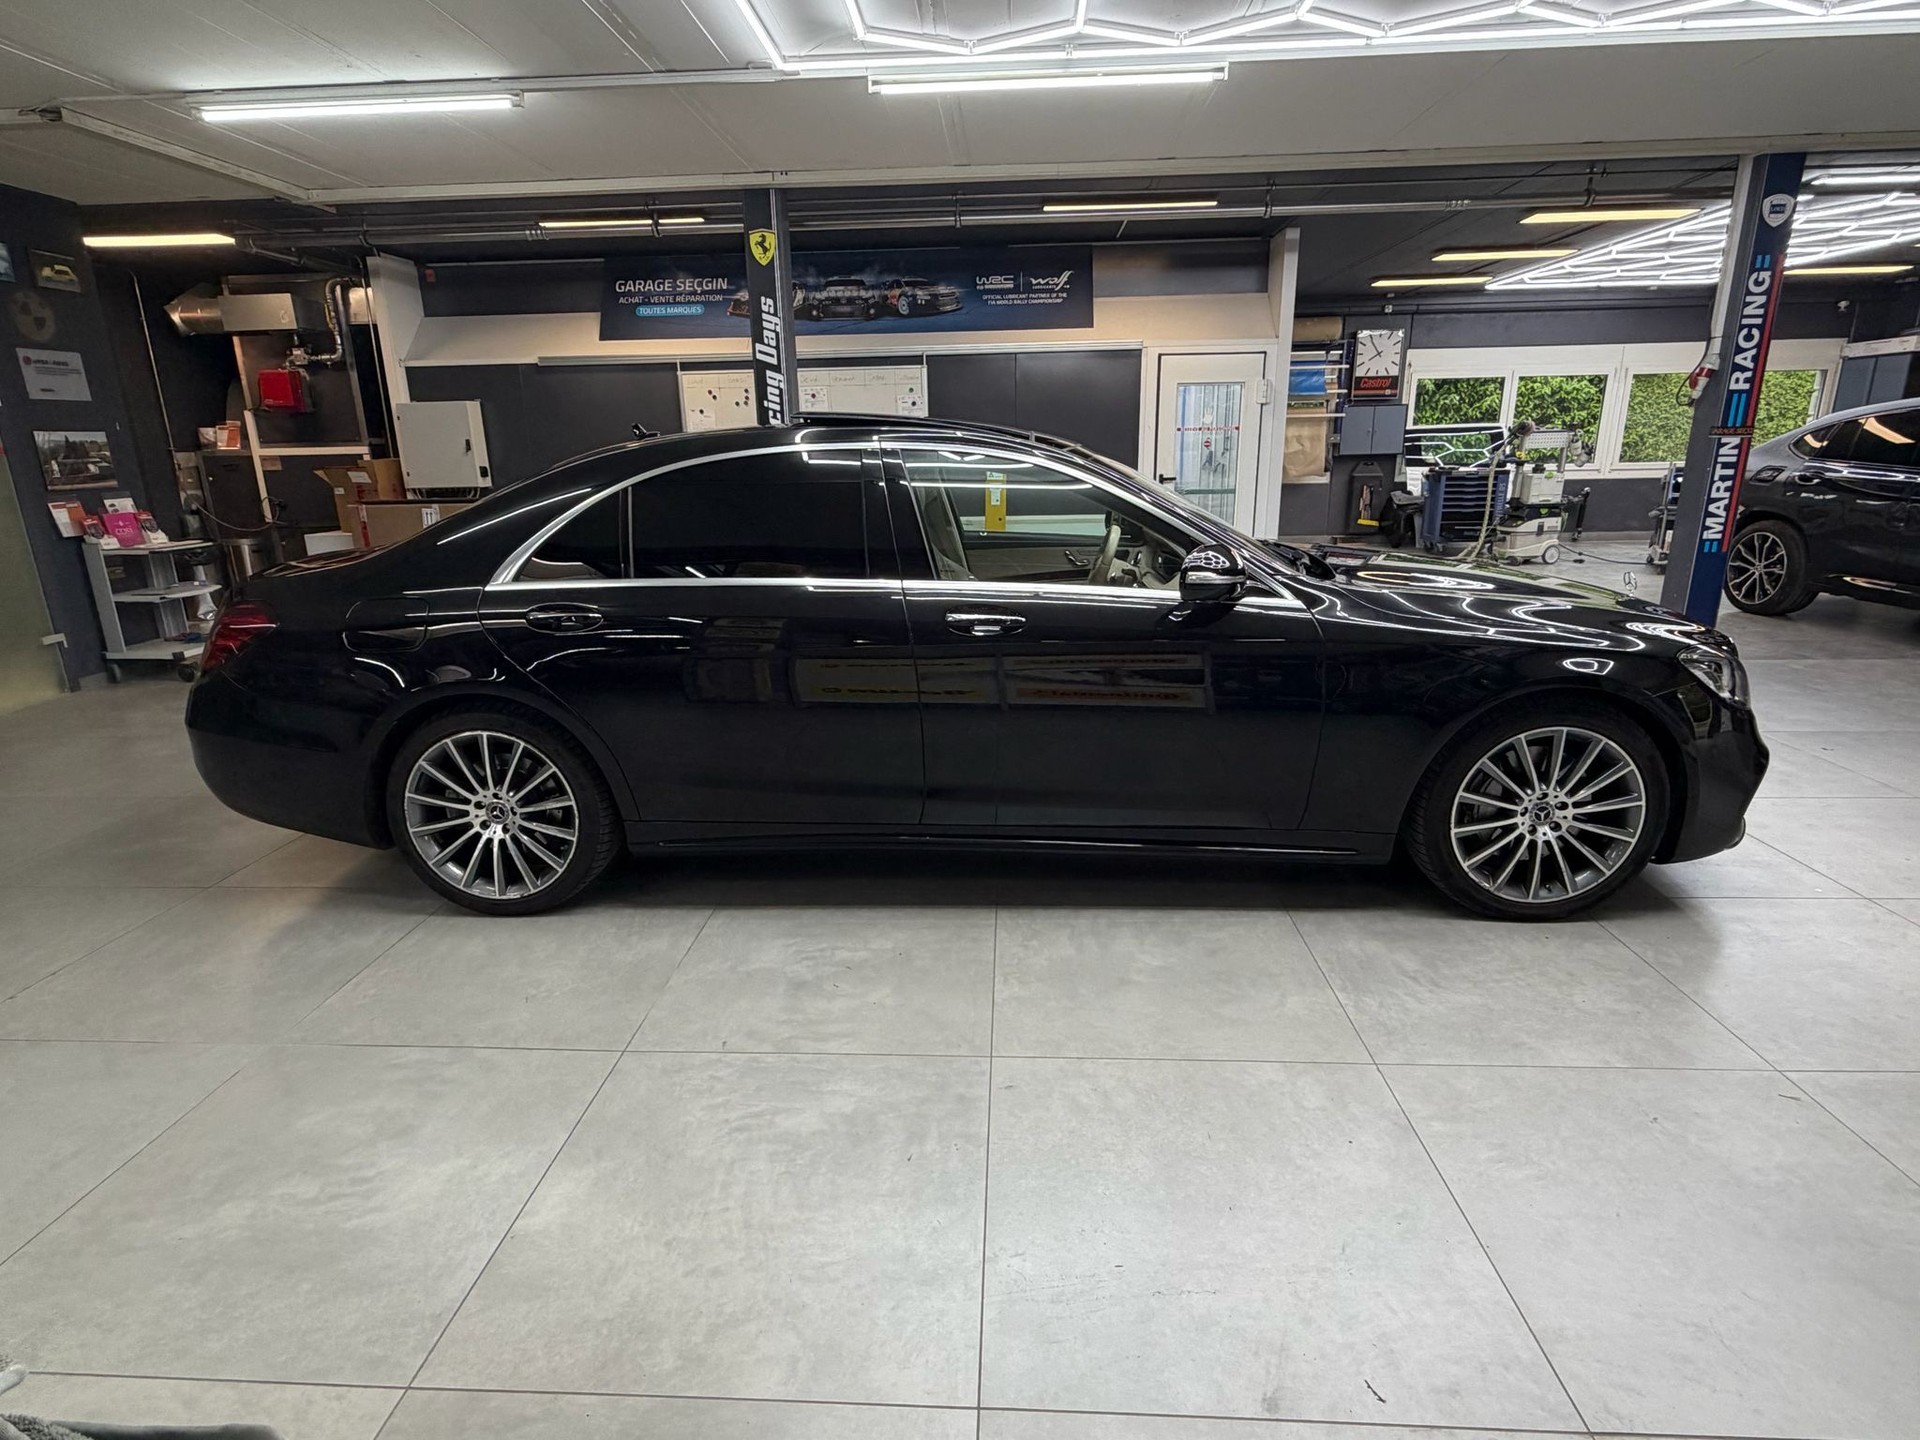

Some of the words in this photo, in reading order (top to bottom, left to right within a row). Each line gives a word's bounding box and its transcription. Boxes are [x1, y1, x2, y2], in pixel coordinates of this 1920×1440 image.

[615, 279, 673, 293] GARAGE
[676, 277, 728, 293] SEÇGIN
[976, 275, 1014, 284] WRC
[618, 296, 643, 304] ACHAT
[650, 295, 675, 303] VENTE
[675, 294, 723, 303] RÉPARATION
[639, 307, 666, 315] TOUTES
[666, 306, 702, 314] MARQUES
[755, 296, 781, 366] Days
[1360, 377, 1392, 389] Castrol
[764, 369, 784, 426] cing
[1702, 436, 1741, 540] MARTIN
[1729, 270, 1773, 391] RACING
